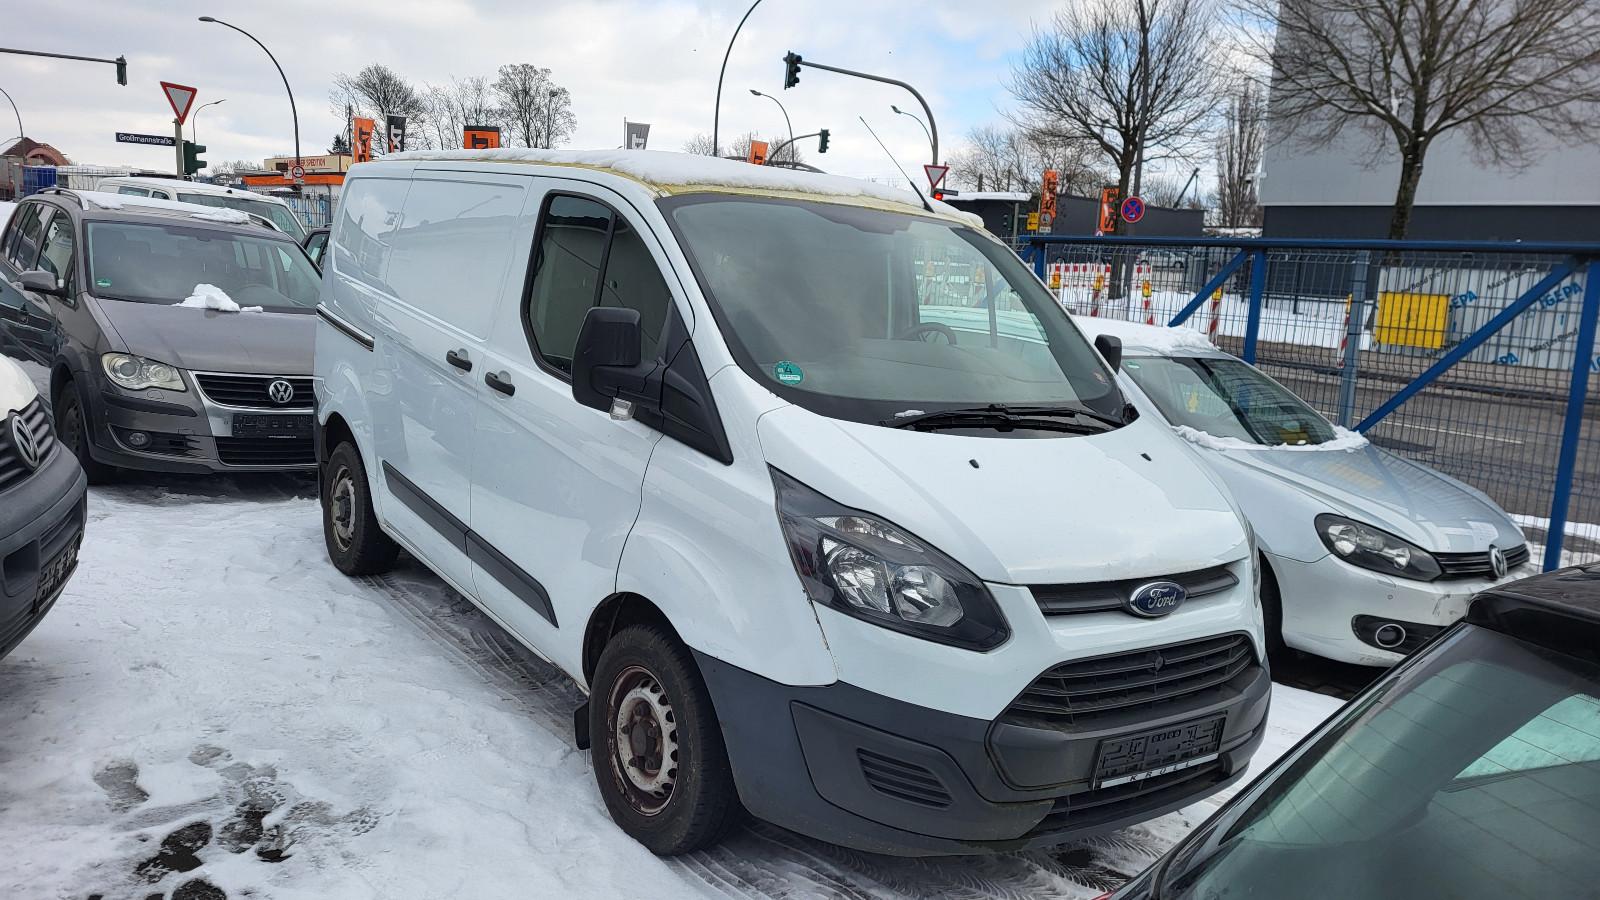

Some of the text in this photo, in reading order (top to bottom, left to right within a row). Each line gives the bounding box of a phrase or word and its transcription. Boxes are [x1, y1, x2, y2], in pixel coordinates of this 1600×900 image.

[118, 133, 173, 145] Großmannstraße
[1540, 282, 1583, 310] IGEPA
[1148, 587, 1177, 609] Ford
